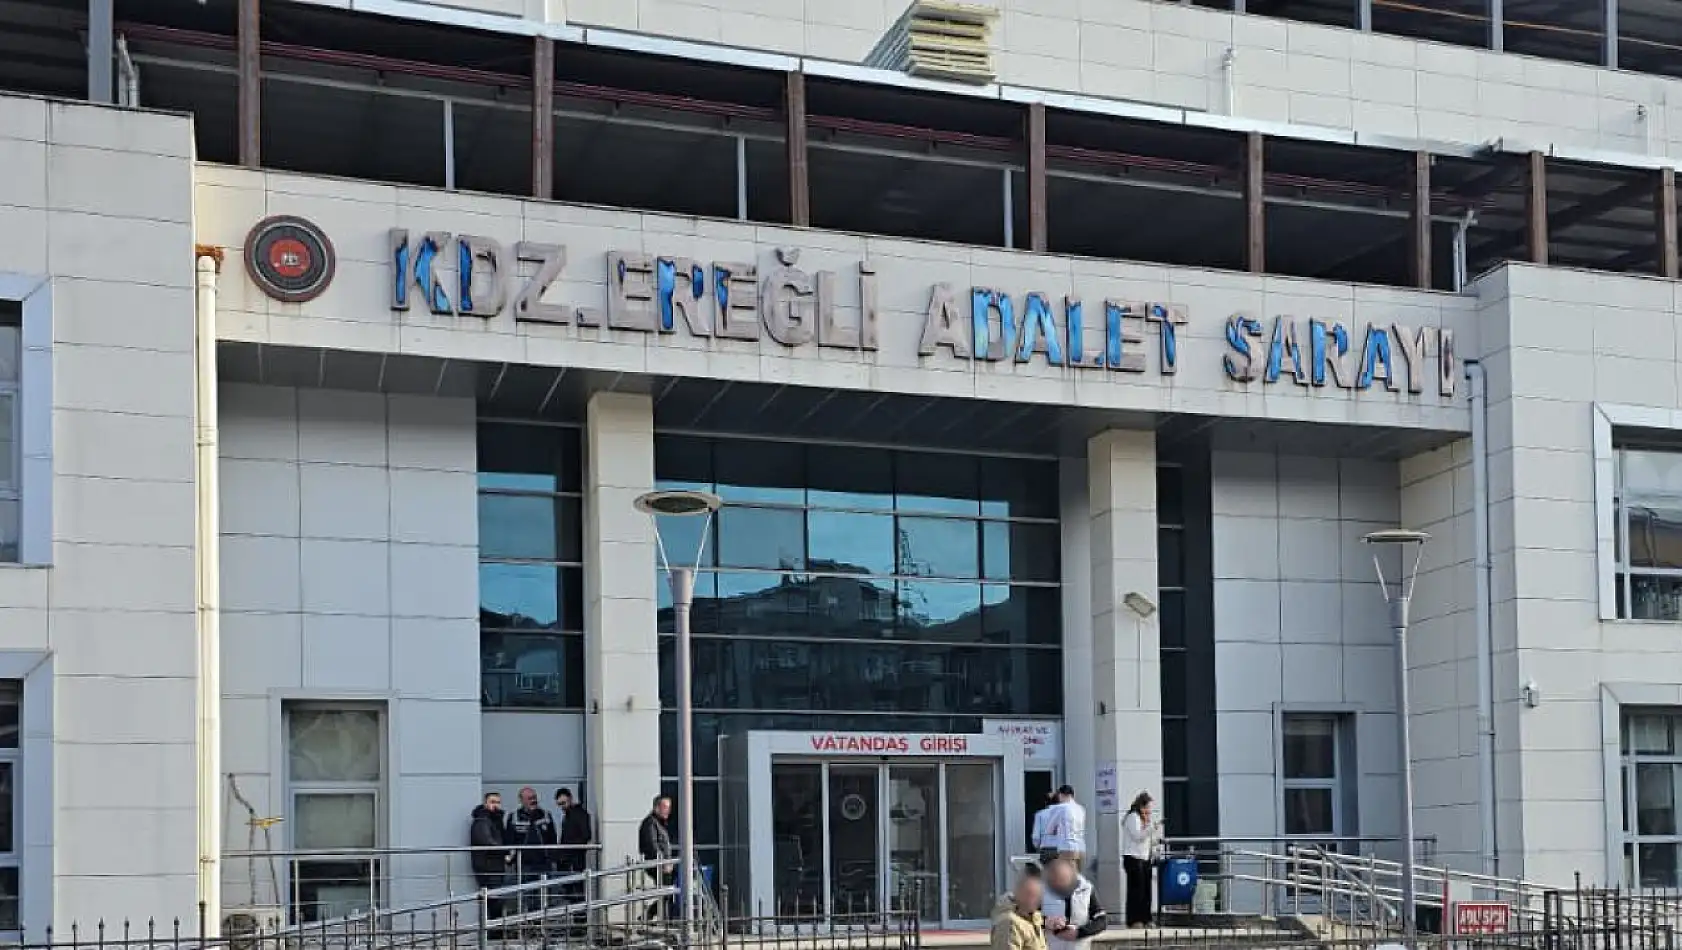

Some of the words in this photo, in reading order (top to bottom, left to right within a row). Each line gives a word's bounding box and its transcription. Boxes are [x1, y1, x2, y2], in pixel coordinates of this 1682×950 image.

[918, 282, 1188, 374] ADALET
[1223, 315, 1455, 397] SARAYI
[811, 733, 909, 753] VATANDAŞ
[919, 734, 968, 753] GİRİŞİ
